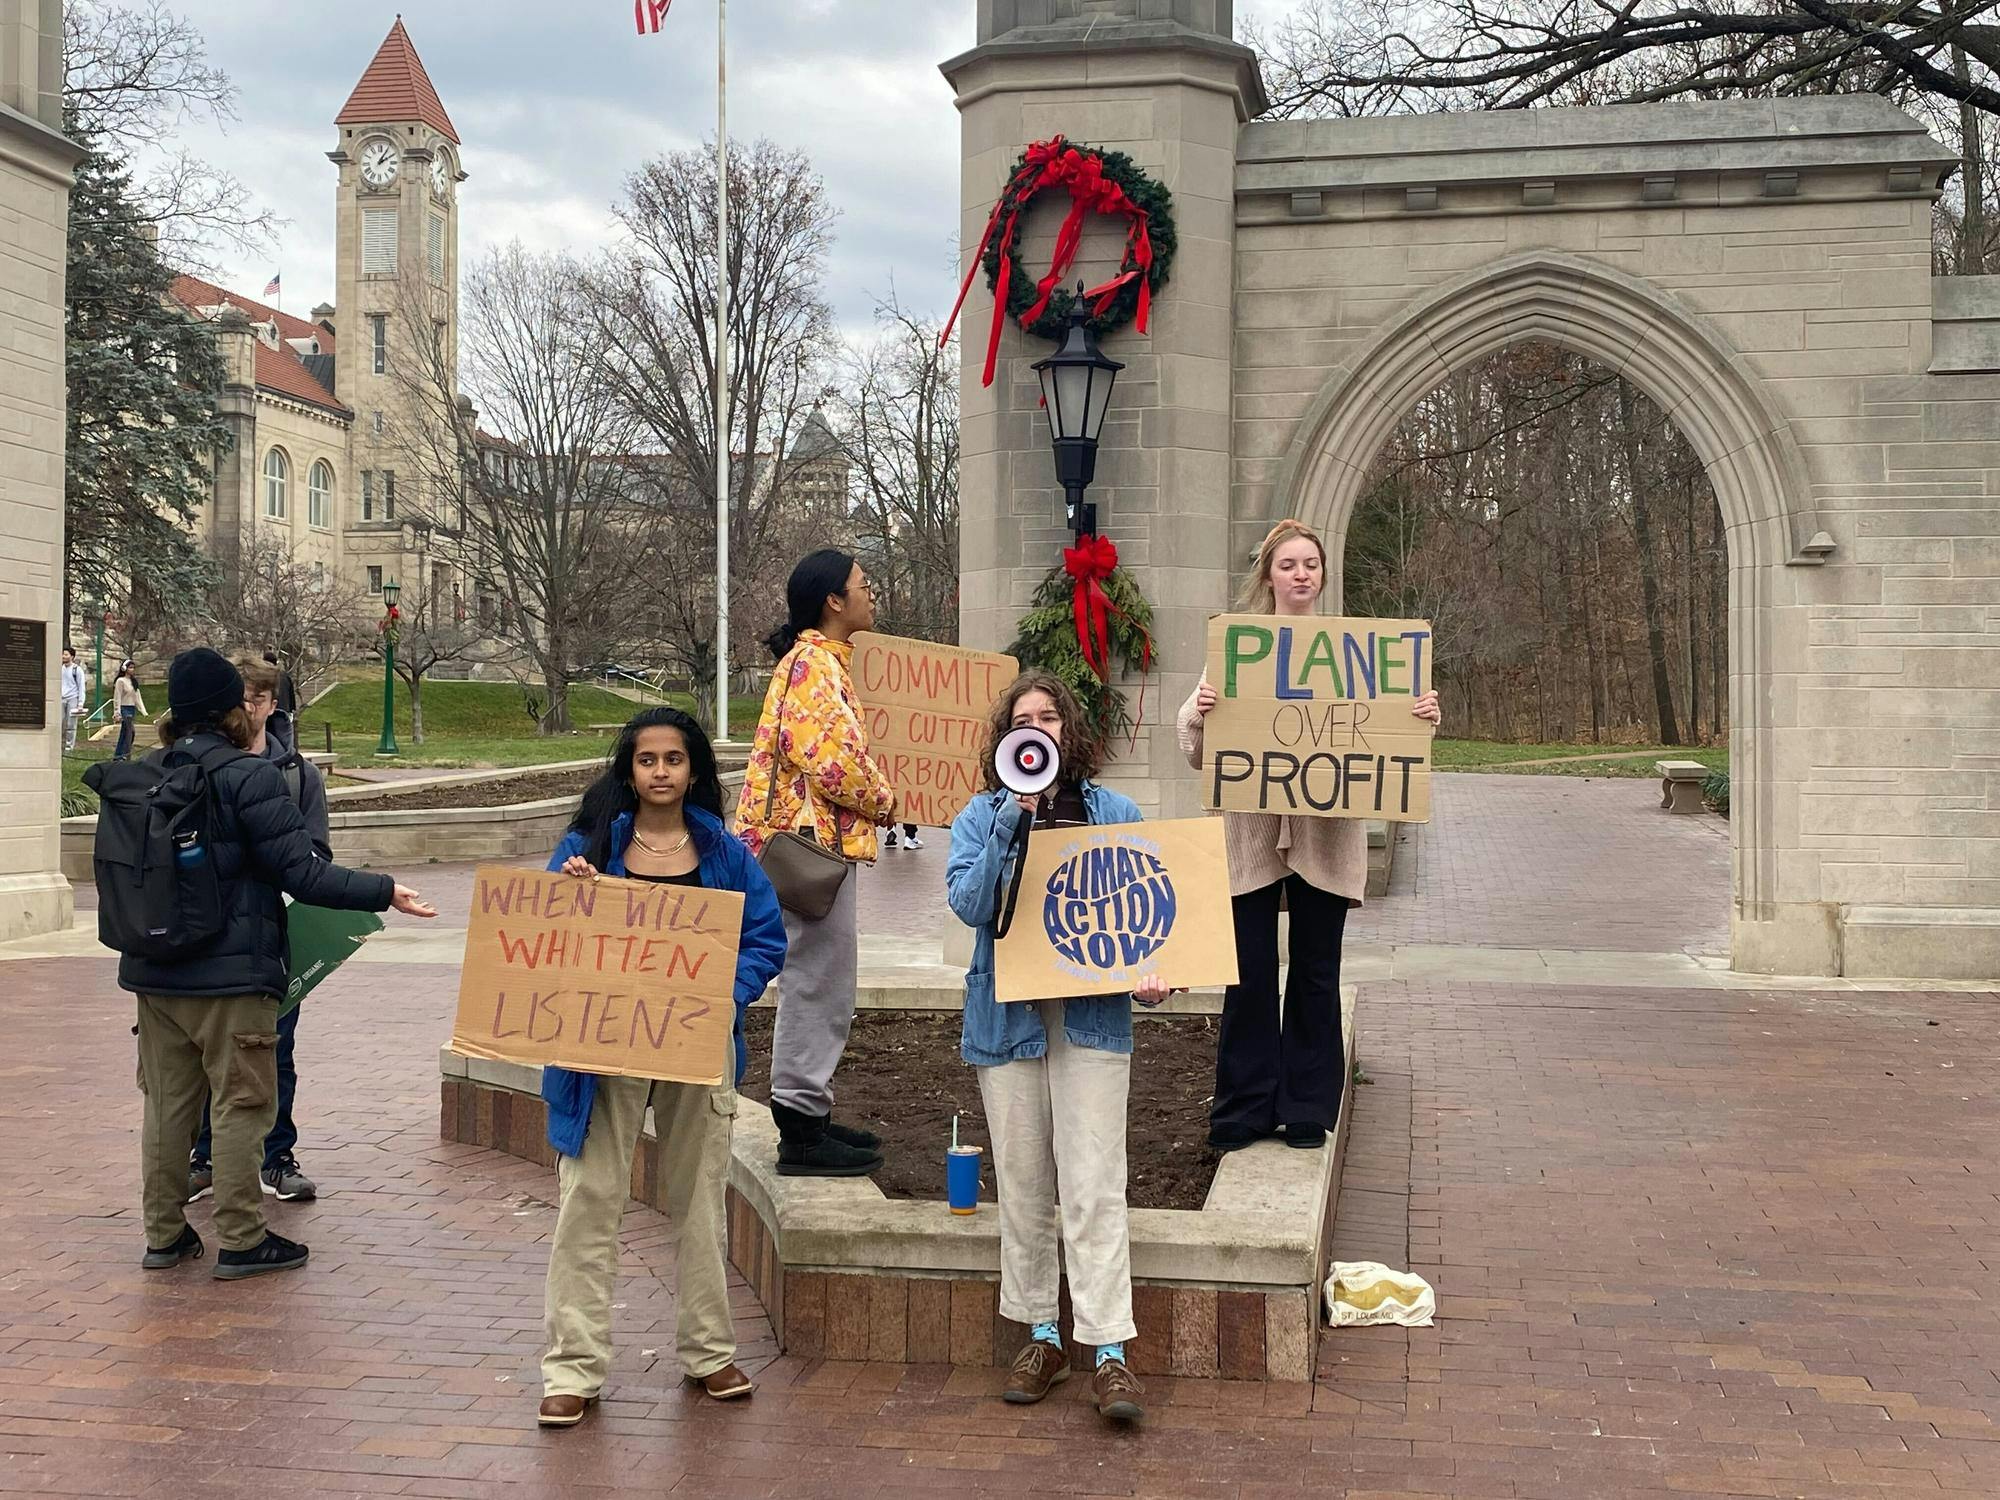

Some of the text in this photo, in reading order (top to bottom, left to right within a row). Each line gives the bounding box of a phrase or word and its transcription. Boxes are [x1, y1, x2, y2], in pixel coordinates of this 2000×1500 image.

[863, 646, 1001, 705] COMMIT
[1224, 624, 1430, 700] PLANET
[908, 711, 990, 748] CUTTI
[1272, 702, 1371, 750] OVER
[876, 753, 979, 794] ARBON
[1212, 750, 1425, 813] PROFIT
[894, 789, 962, 825] MISS
[1046, 846, 1168, 899] CLIMATE
[480, 877, 722, 935] WHEN WILL
[1043, 875, 1177, 946] ACTION
[498, 928, 709, 980] WHITTEN
[1055, 931, 1167, 969] NOW
[492, 989, 711, 1050] LISTEN?
